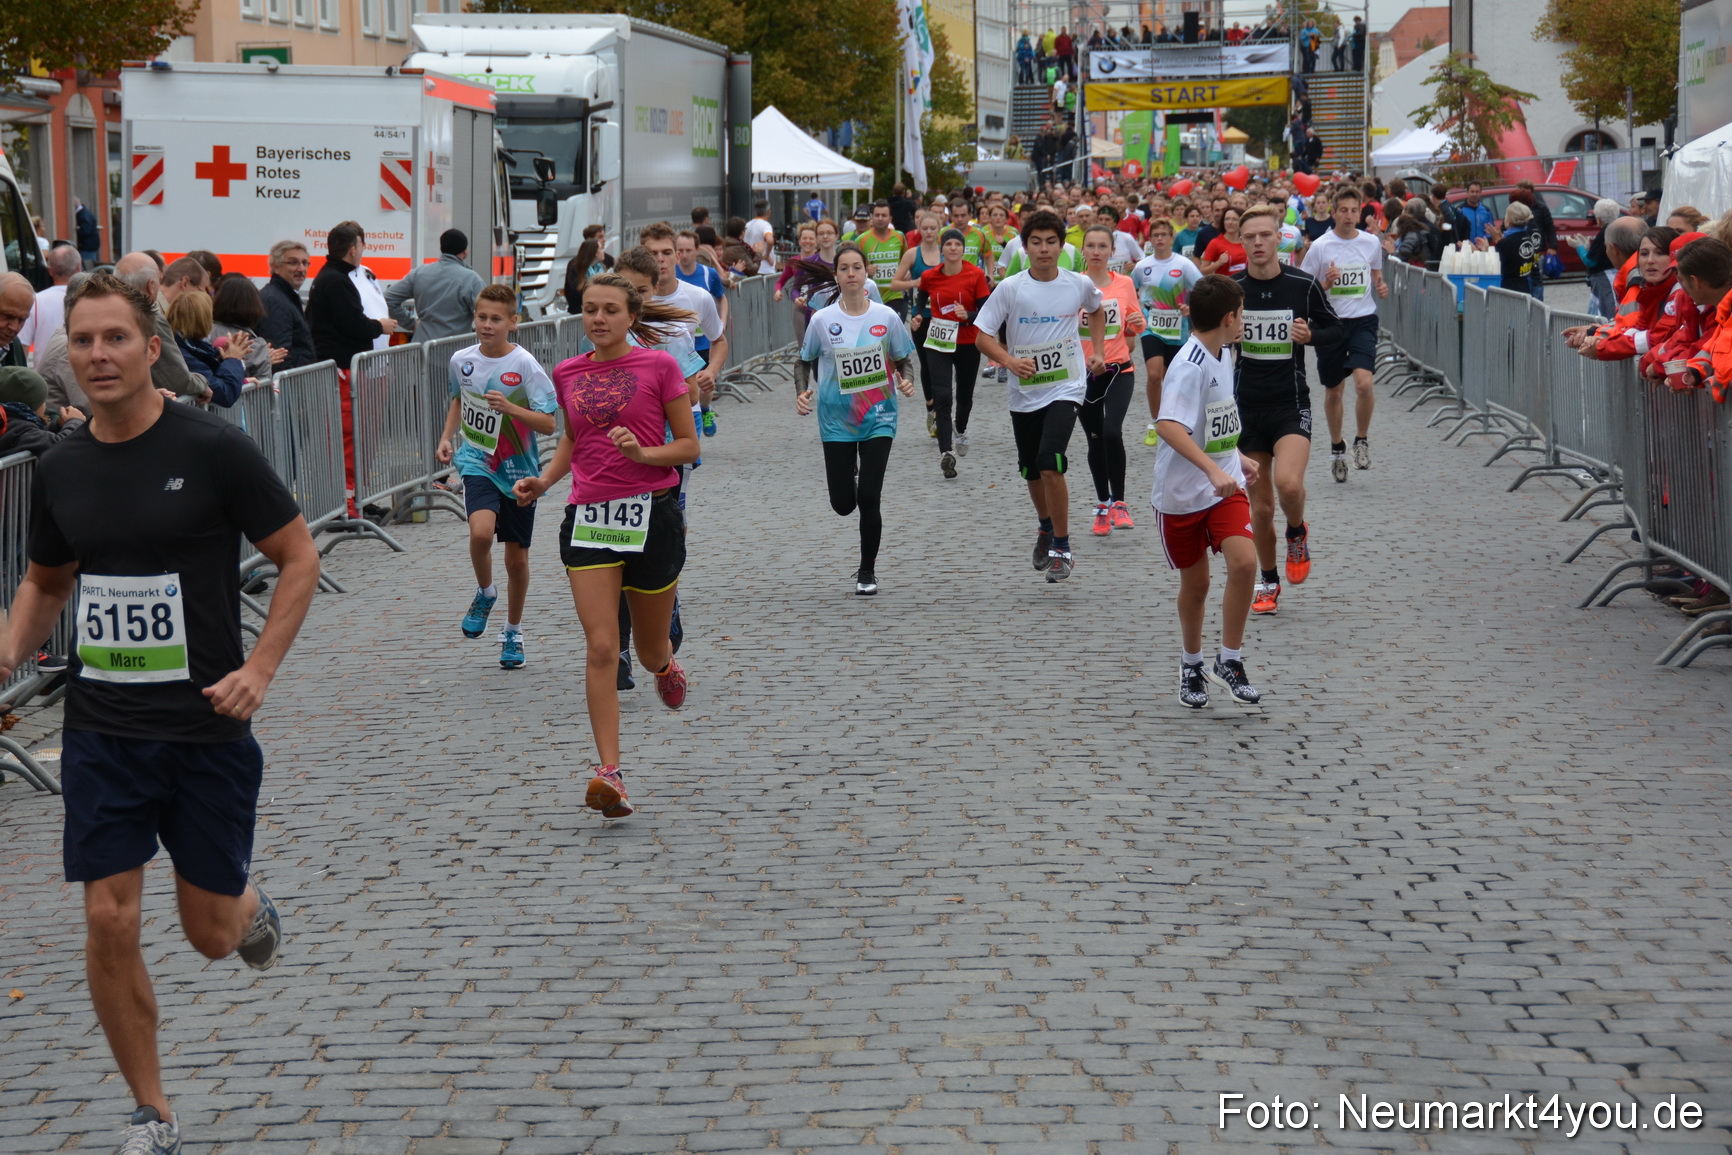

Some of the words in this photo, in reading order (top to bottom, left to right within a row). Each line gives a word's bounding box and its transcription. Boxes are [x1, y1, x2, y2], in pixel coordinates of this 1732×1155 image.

[449, 74, 535, 92] OCK
[1151, 86, 1219, 103] START
[692, 95, 719, 158] BOCK
[374, 130, 406, 139] 44/54/1
[256, 146, 351, 162] Bayerisches
[256, 166, 300, 179] Rotes
[758, 173, 820, 186] Laufsport
[256, 186, 300, 199] Kreuz
[868, 252, 900, 260] BOCK
[1152, 316, 1179, 328] 5007
[930, 326, 954, 340] 5067
[1244, 323, 1288, 341] 5148
[854, 348, 877, 356] Neumarkt
[1032, 345, 1055, 354] Neumarkt
[1249, 345, 1280, 353] Christian
[842, 354, 881, 377] 5026
[1021, 352, 1062, 372] 192
[1032, 374, 1055, 384] Jeffrey
[463, 402, 496, 434] 5060
[1212, 410, 1239, 437] 5038
[584, 500, 644, 527] 5143
[590, 530, 630, 543] Veronika
[82, 585, 106, 596] PARTL
[108, 588, 160, 598] Neumarkt
[87, 602, 174, 642] 5158
[110, 652, 146, 668] Marc
